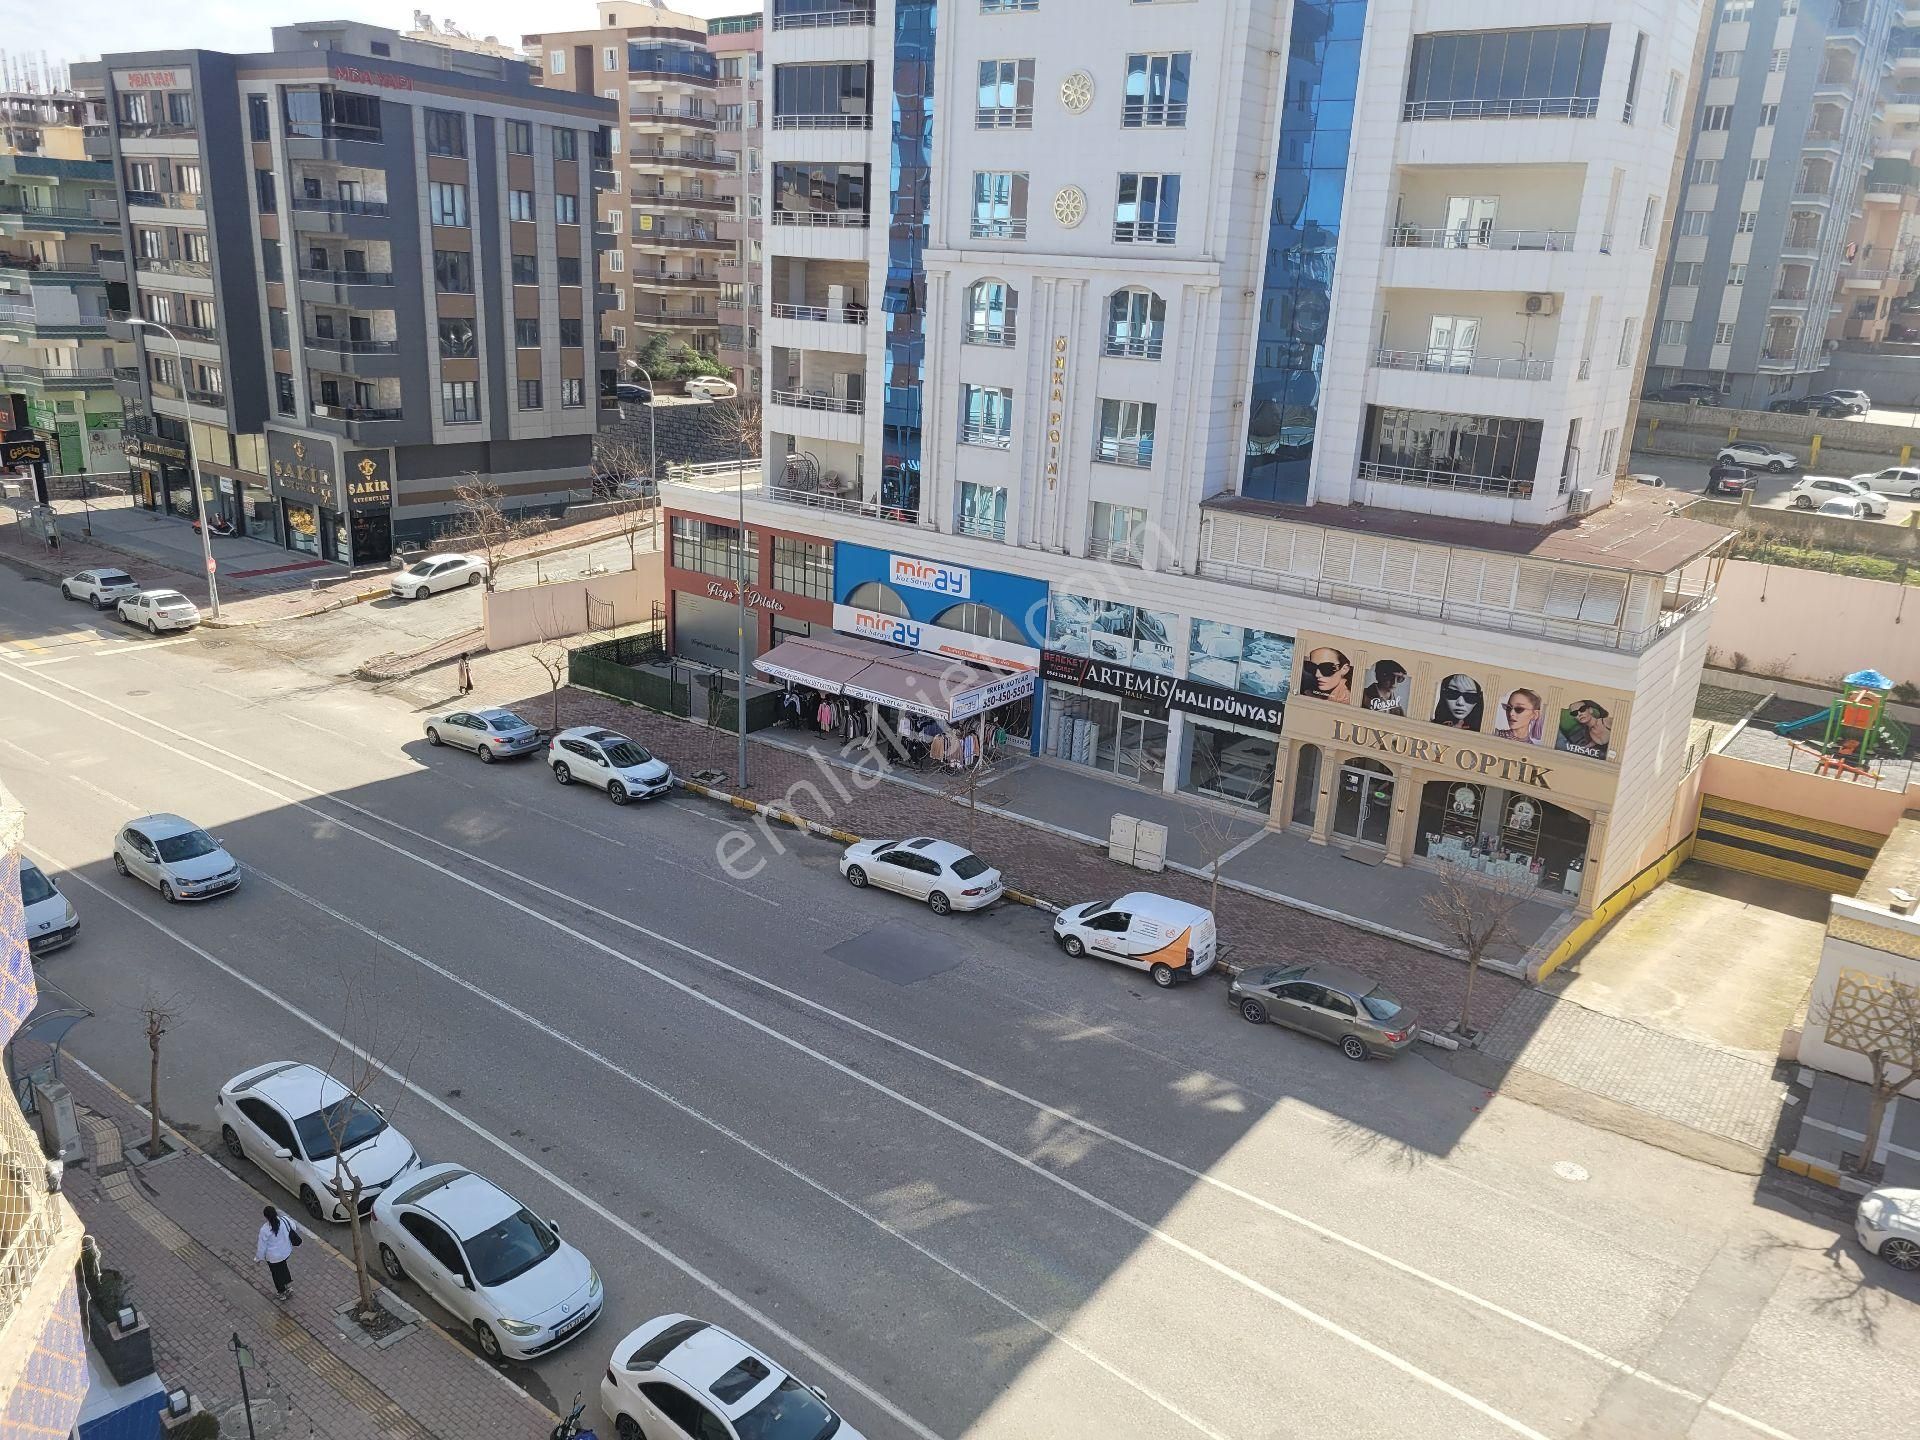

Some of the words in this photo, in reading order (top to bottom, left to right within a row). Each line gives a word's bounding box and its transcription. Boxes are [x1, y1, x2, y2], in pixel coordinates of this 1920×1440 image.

[1047, 412, 1061, 491] POINT
[896, 560, 963, 593] miray
[896, 574, 910, 583] Kot
[748, 590, 784, 611] Pilates
[856, 614, 920, 647] miray
[1043, 652, 1084, 668] BEREKET
[1085, 665, 1170, 697] ARTEMİS
[1175, 688, 1211, 709] HALI
[1213, 695, 1283, 726] DÜNYASI
[1331, 719, 1451, 764] LUXURY
[1455, 749, 1553, 790] OPTİK
[1566, 742, 1600, 757] VERSACE
